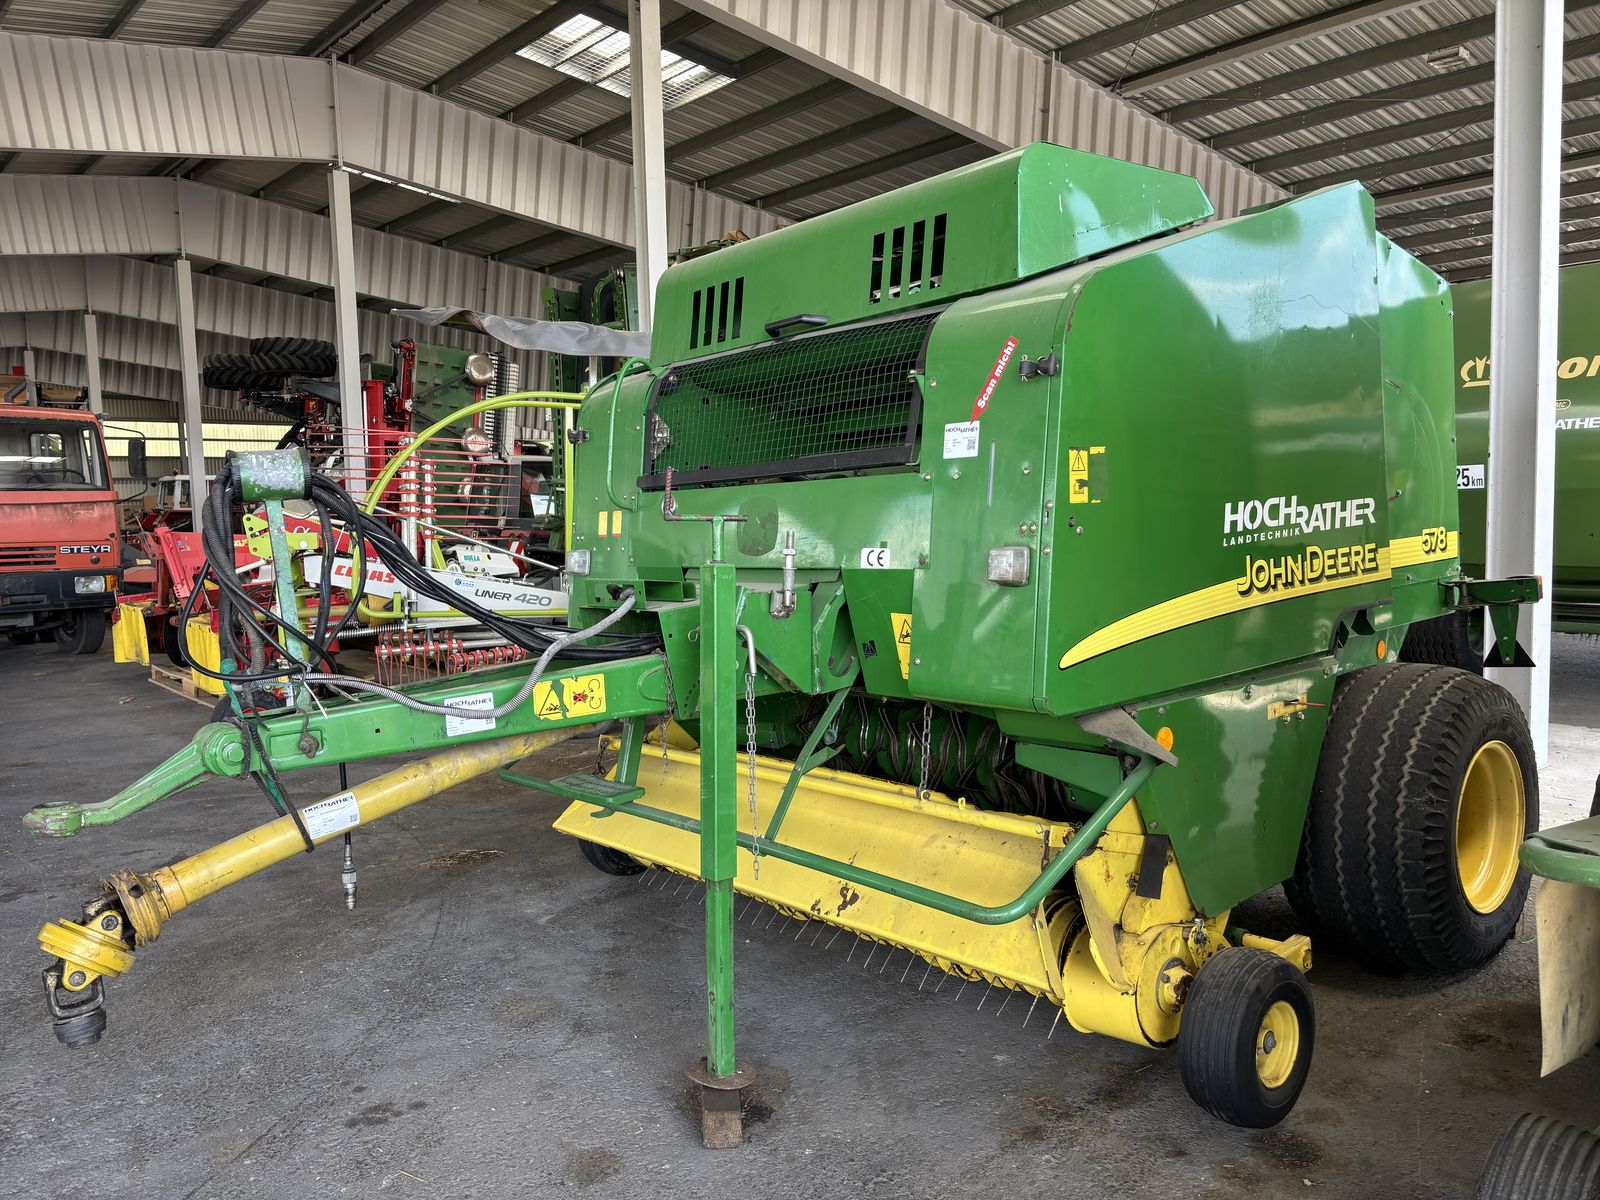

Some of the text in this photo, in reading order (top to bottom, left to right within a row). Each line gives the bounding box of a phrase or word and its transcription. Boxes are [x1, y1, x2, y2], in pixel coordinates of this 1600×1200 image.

[977, 341, 1016, 409] Scan mich!
[1471, 476, 1484, 487] km
[1223, 495, 1376, 534] HOCHRATHER
[1223, 527, 1300, 547] LANDTECHNIK
[1422, 526, 1448, 555] 578
[60, 544, 111, 554] STEYR
[867, 549, 885, 567] CE
[1237, 543, 1379, 597] JOHN DEERE
[474, 588, 553, 607] LINER 420
